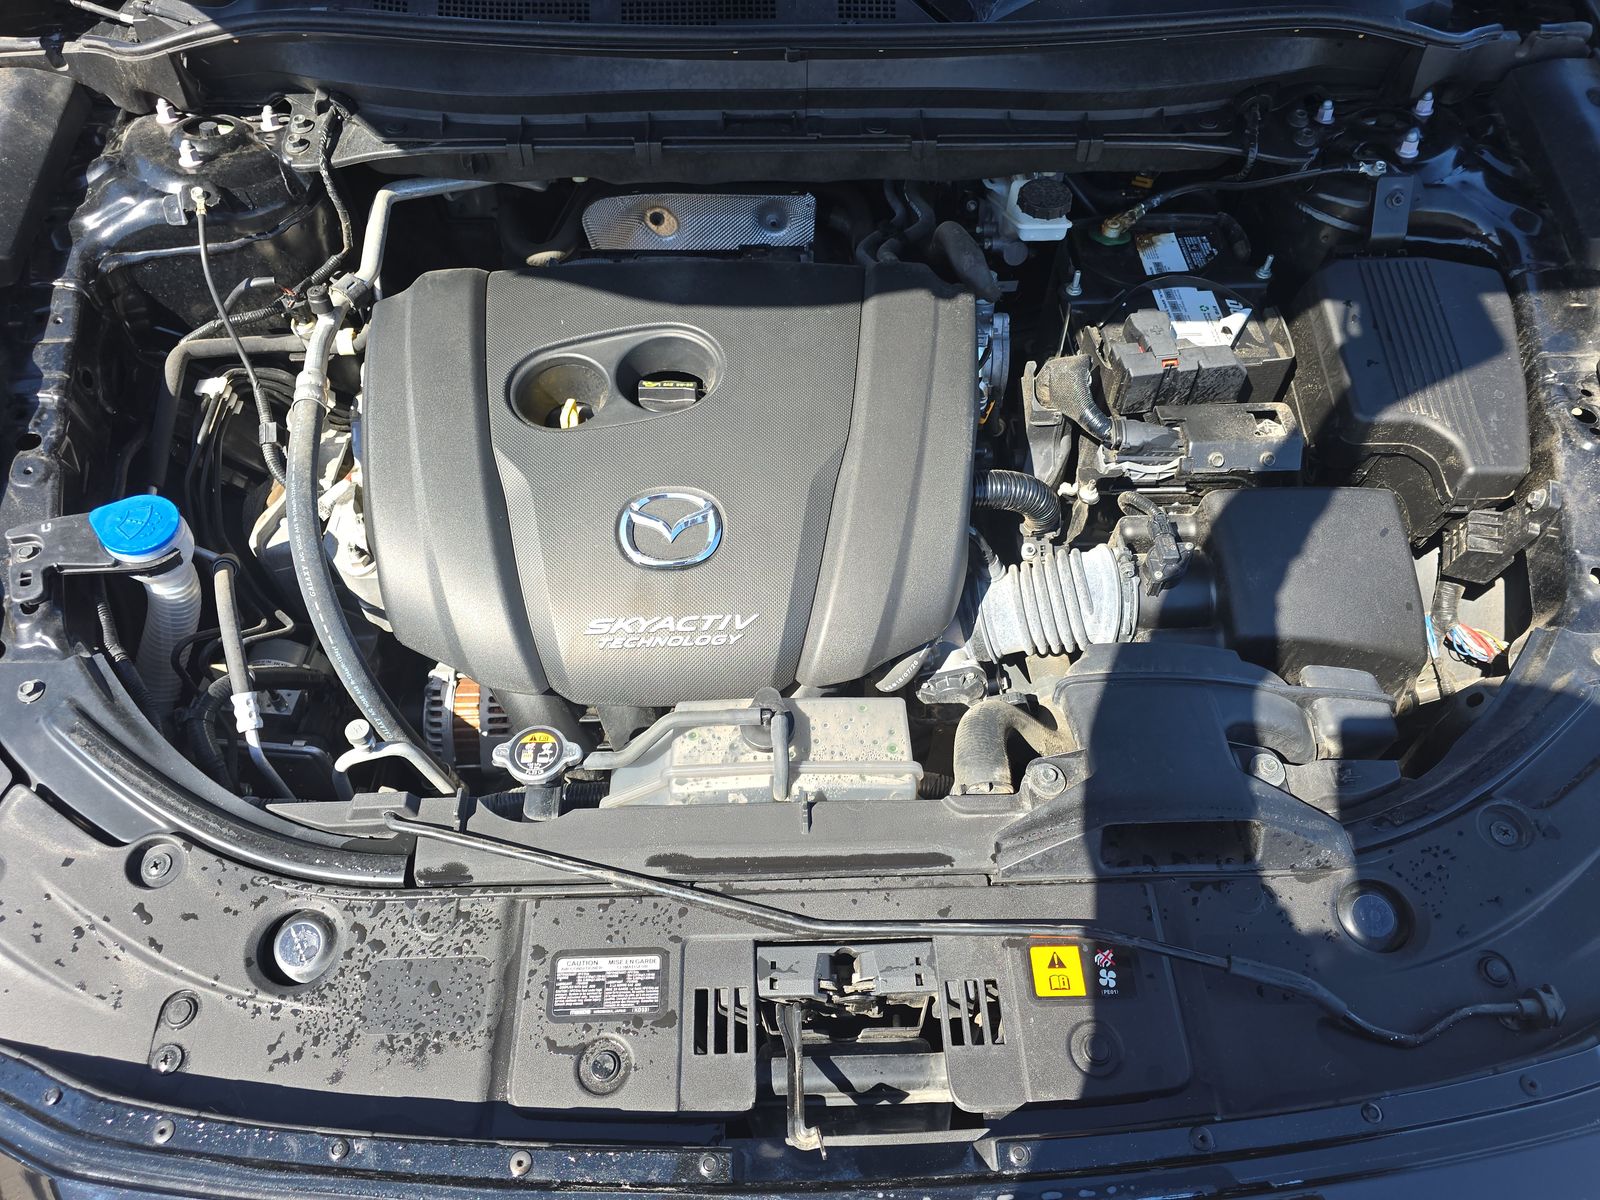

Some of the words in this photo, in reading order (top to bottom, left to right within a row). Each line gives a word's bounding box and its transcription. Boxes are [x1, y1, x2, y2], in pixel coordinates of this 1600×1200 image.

[301, 565, 317, 597] GALAXY
[583, 613, 761, 635] SKYACTIV
[599, 633, 745, 650] TECHNOLOGY
[566, 959, 599, 967] CAUTION
